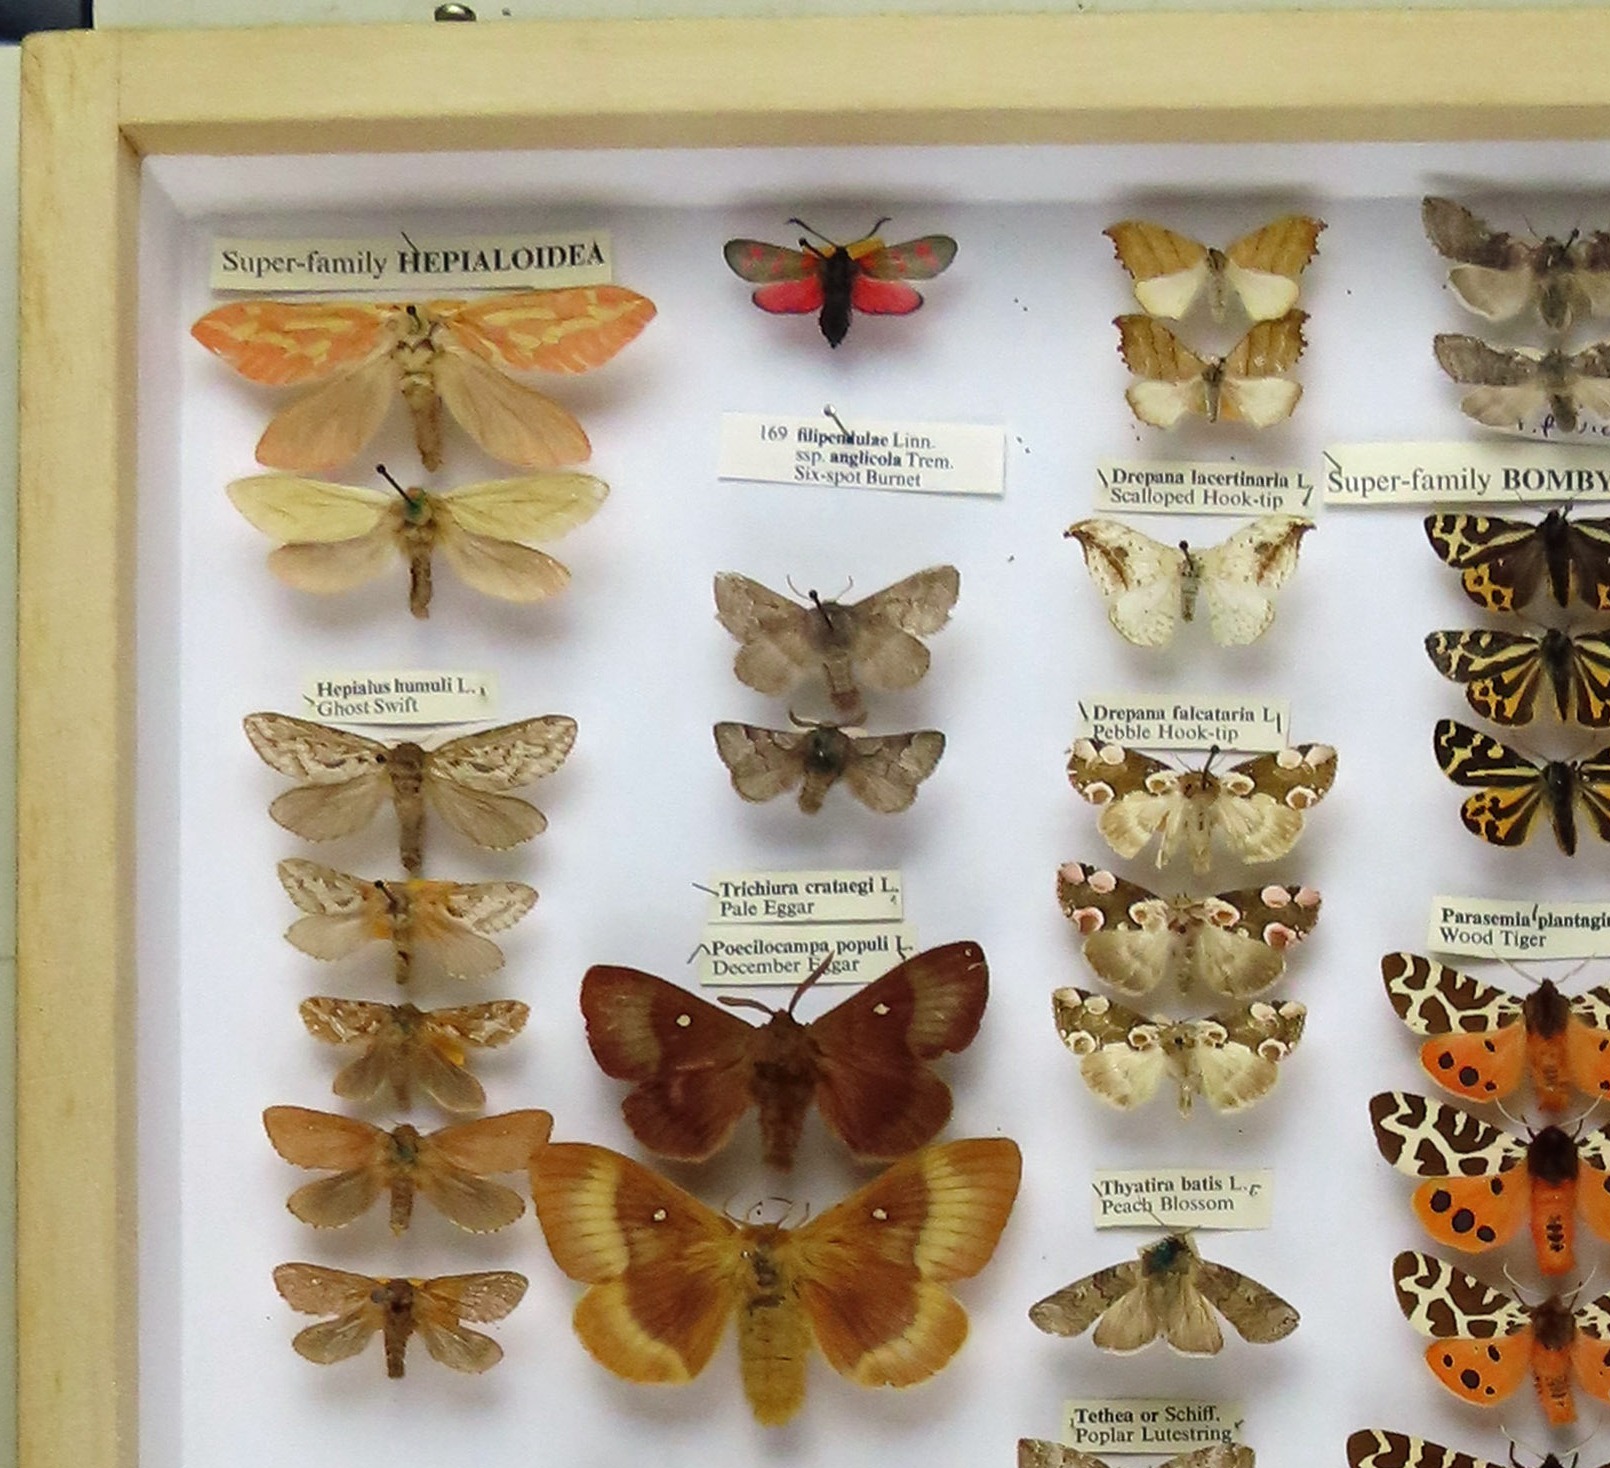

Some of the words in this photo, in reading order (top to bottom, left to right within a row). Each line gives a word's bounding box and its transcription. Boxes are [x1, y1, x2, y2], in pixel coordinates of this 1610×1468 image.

[222, 250, 387, 279] Super-family
[399, 243, 606, 274] HEPIALOIDEA
[760, 425, 788, 442] 169
[830, 450, 901, 468] anglicola
[905, 451, 955, 470] Trem.
[794, 465, 861, 488] Six-spot
[866, 469, 921, 488] Burnet
[1328, 468, 1491, 497] Super-family
[1111, 487, 1194, 508] Scalloped
[1203, 488, 1284, 510] Hook-tip
[317, 681, 391, 700] Hepialus
[394, 678, 452, 694] humuli
[317, 699, 369, 717] Ghost
[374, 698, 419, 714] Swift
[1093, 724, 1151, 740] Pebble
[1158, 724, 1239, 743] Hook-tip
[720, 880, 799, 898] Trichiura
[806, 878, 875, 899] crataegi
[720, 900, 757, 917] Pale
[763, 899, 814, 916] Eggar
[1441, 907, 1531, 926] Parasemia
[1439, 927, 1494, 945] Wood
[1500, 930, 1547, 949] Tiger
[1101, 1178, 1174, 1197] Thyatira
[1181, 1176, 1222, 1193] batis
[1101, 1198, 1152, 1214] Peach
[1160, 1197, 1234, 1212] Blossom
[1076, 1407, 1133, 1424] Tethea
[1140, 1411, 1158, 1423] or
[1164, 1405, 1221, 1422] Schiff.
[1076, 1428, 1134, 1446] Poplar
[1142, 1426, 1232, 1443] Lutestring
